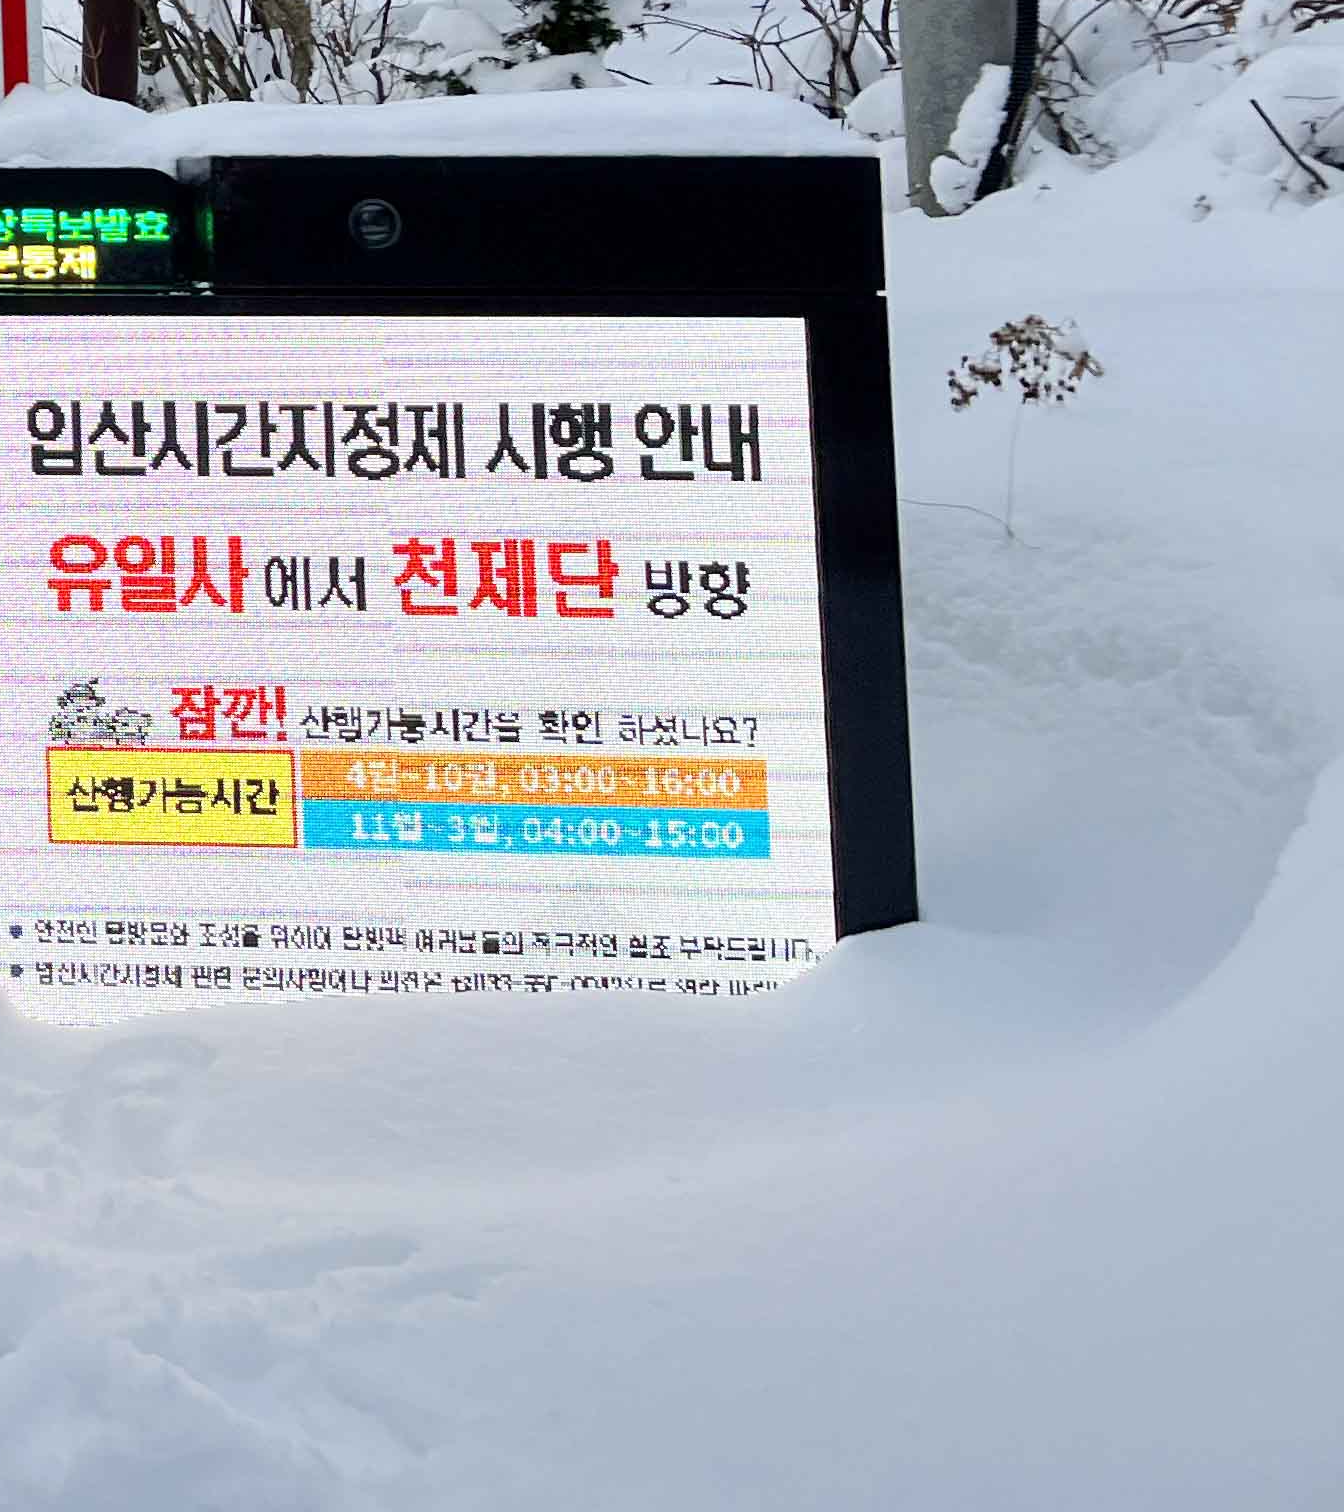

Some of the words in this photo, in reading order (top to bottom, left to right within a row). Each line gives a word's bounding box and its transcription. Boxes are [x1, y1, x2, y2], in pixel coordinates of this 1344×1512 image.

[27, 399, 466, 481] 입산시간지정제
[485, 402, 615, 483] 시행
[634, 403, 762, 482] 안내
[47, 534, 250, 614] 유일사
[264, 555, 367, 612] 에서
[392, 536, 619, 619] 천제단
[645, 560, 751, 620] 방향
[170, 684, 289, 742] 잠깐!
[538, 710, 604, 745] 확인
[619, 714, 758, 748] 하셨나요?
[66, 776, 281, 816] 산행가능시간
